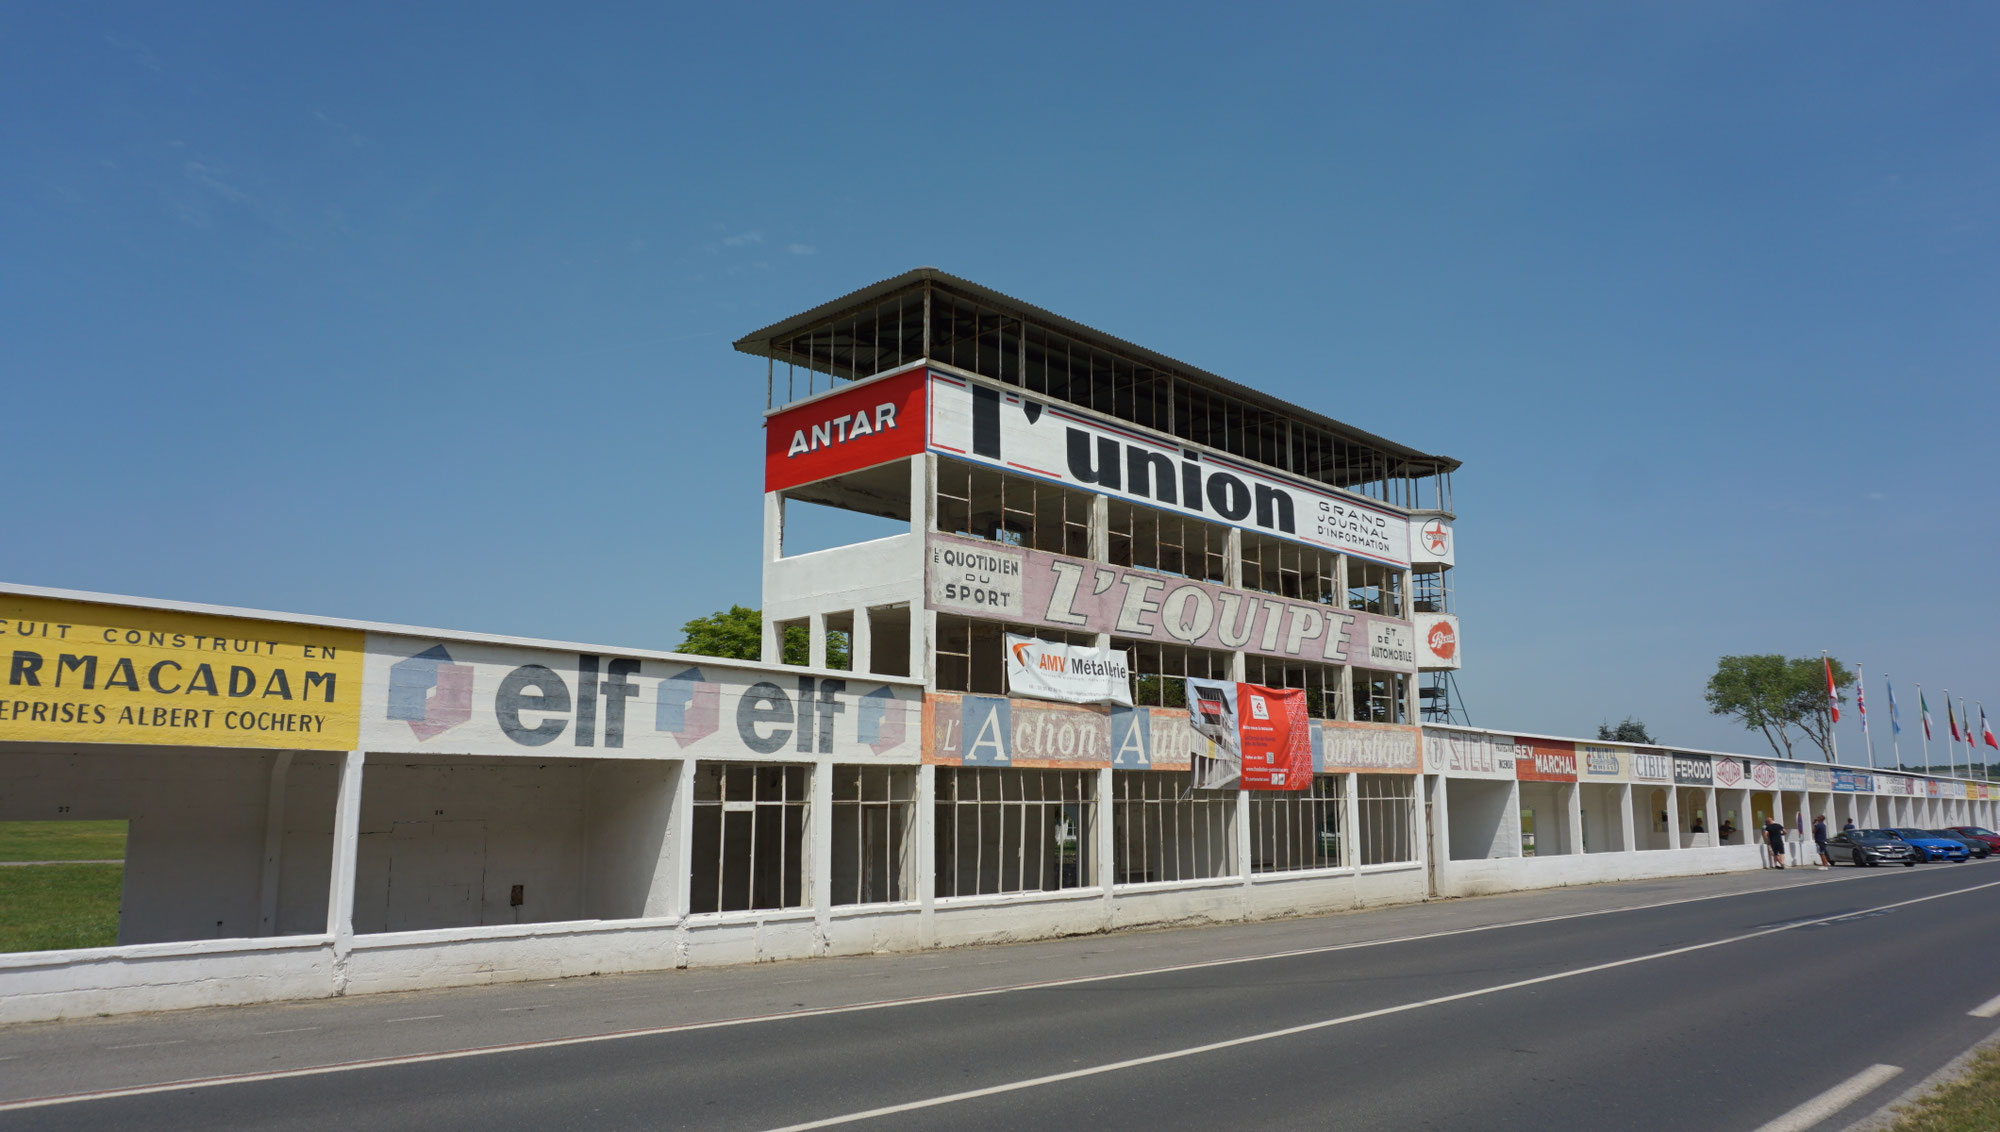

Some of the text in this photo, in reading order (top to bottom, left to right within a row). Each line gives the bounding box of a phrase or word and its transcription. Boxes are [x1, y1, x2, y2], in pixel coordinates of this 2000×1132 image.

[787, 401, 897, 458] ANTAR
[972, 384, 1296, 535] l'union
[1318, 501, 1386, 528] GRAND
[1317, 515, 1389, 541] JOURNAL
[1317, 525, 1390, 552] D'INFORMATION
[944, 550, 1019, 576] QUOTIDIEN
[966, 573, 990, 584] DU
[945, 583, 1011, 608] SPORT
[1044, 559, 1356, 662] L'EQUIPE
[103, 628, 279, 655] CONSTRUIT
[303, 644, 337, 660] EN
[1377, 635, 1389, 644] DE
[1385, 627, 1397, 637] ET
[1039, 653, 1066, 673] AMV
[1371, 648, 1412, 663] AUTOMOBILE
[9, 649, 337, 704] RMACADAM
[495, 654, 642, 749] elf
[0, 699, 326, 734] EPRISES ALBERT COCHERY
[736, 676, 846, 755] elf
[1535, 754, 1577, 775] MARCHAL
[1674, 759, 1712, 779] FERODO
